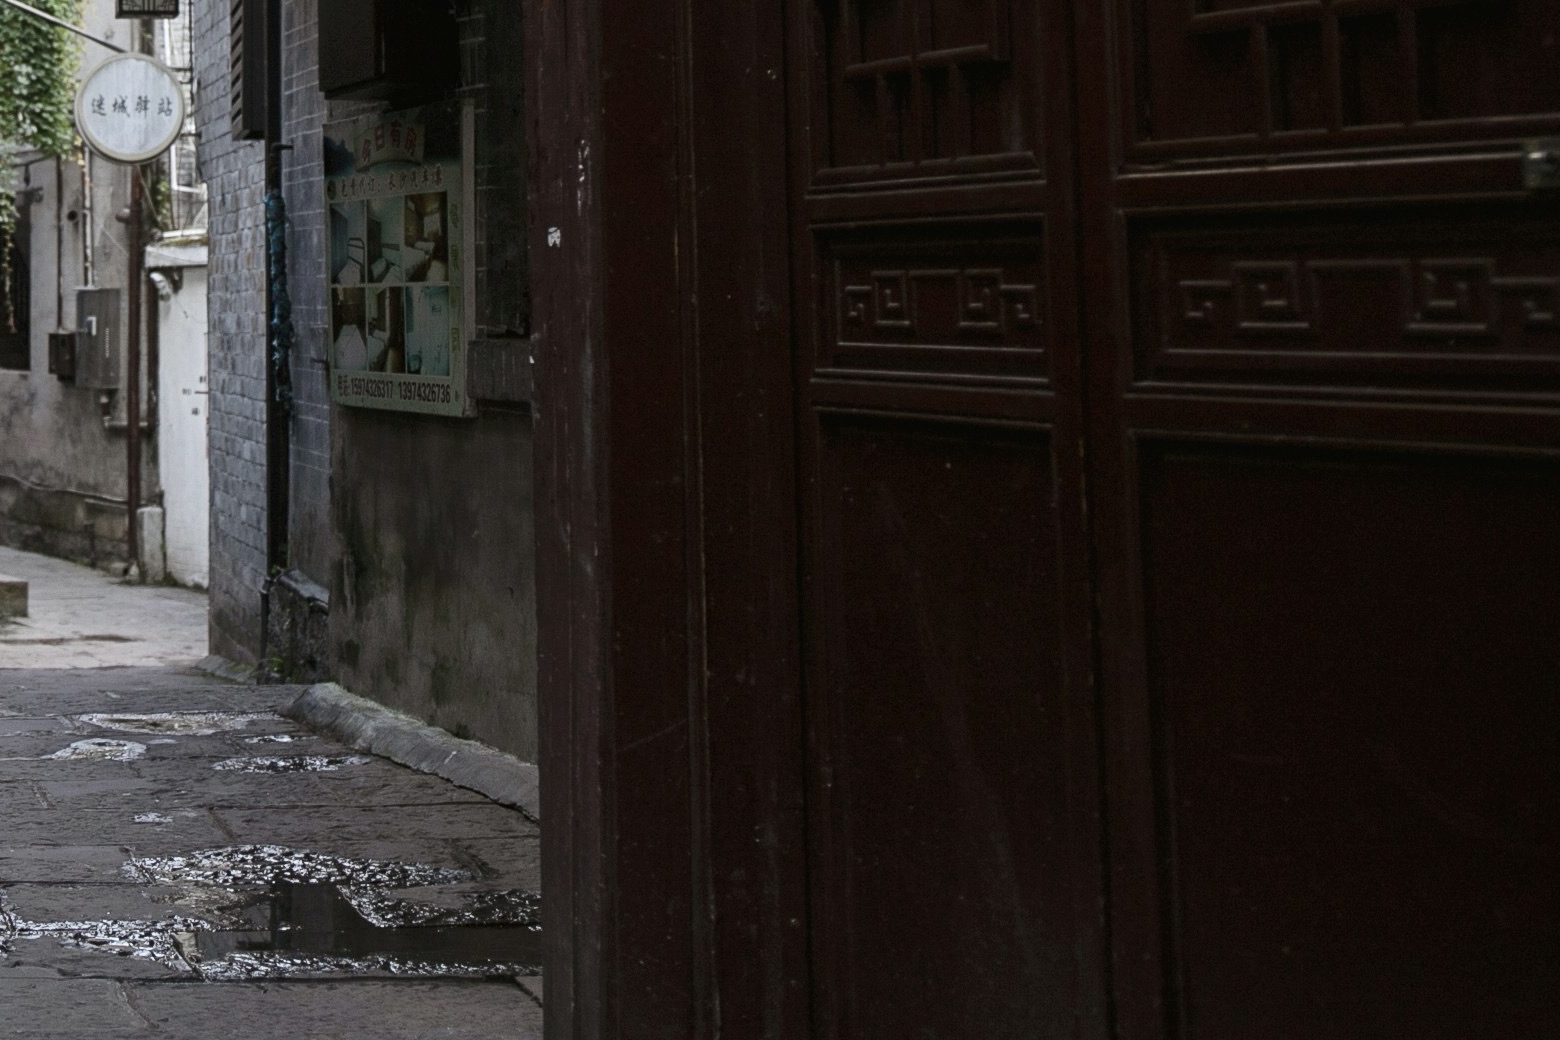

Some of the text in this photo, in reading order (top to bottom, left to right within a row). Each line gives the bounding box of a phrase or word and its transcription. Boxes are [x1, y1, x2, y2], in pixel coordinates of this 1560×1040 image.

[362, 120, 418, 163] 今日有房
[398, 381, 451, 403] 13974326736
